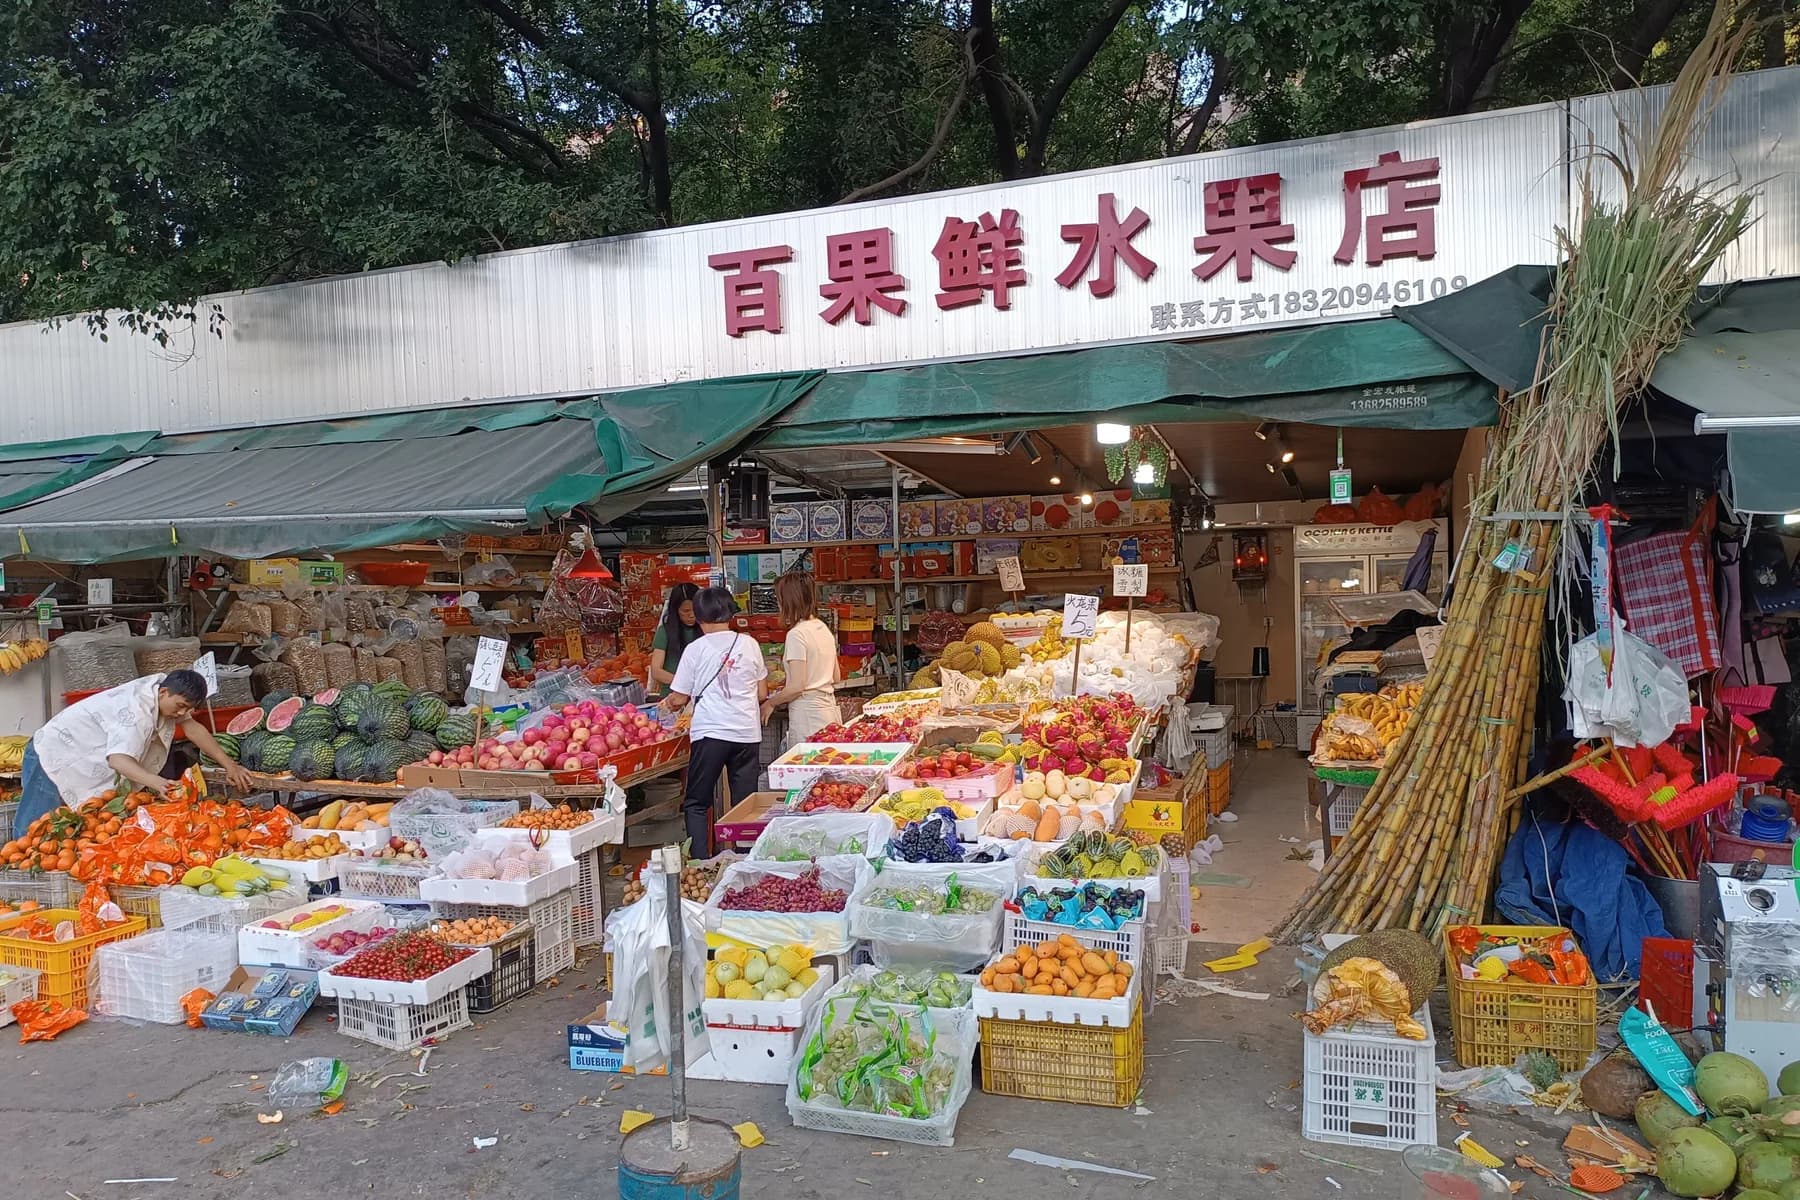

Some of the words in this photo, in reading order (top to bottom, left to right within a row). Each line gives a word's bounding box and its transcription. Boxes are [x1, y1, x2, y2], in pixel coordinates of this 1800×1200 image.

[708, 151, 1441, 338] 百果鲜水果店
[1151, 275, 1468, 331] 联系方式18320946109
[1358, 526, 1394, 535] KETTLE
[1117, 567, 1144, 578] 冰糖
[1066, 594, 1098, 611] 火龙果
[576, 1055, 621, 1068] BLUEBERRY
